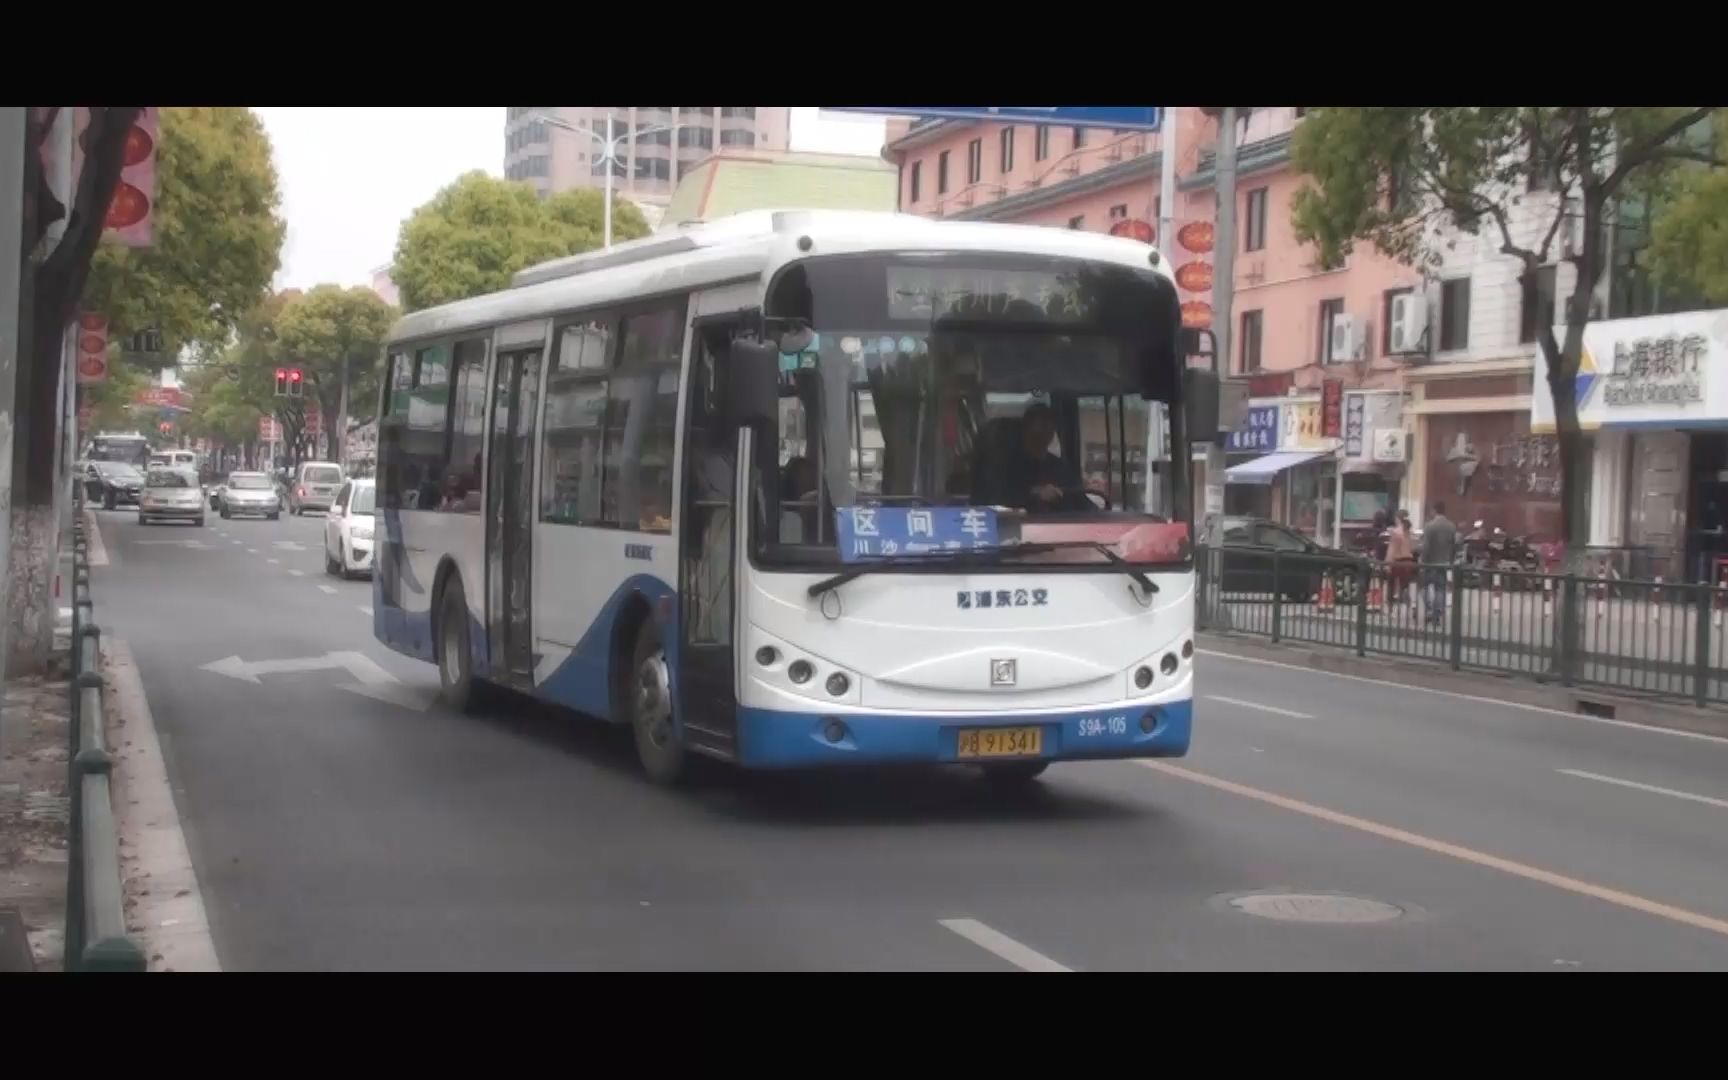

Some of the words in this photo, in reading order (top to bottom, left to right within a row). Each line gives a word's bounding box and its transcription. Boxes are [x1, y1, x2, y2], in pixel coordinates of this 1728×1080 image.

[1608, 336, 1708, 379] 上海银行
[852, 508, 988, 537] 区间车
[1078, 717, 1127, 737] S9A-105
